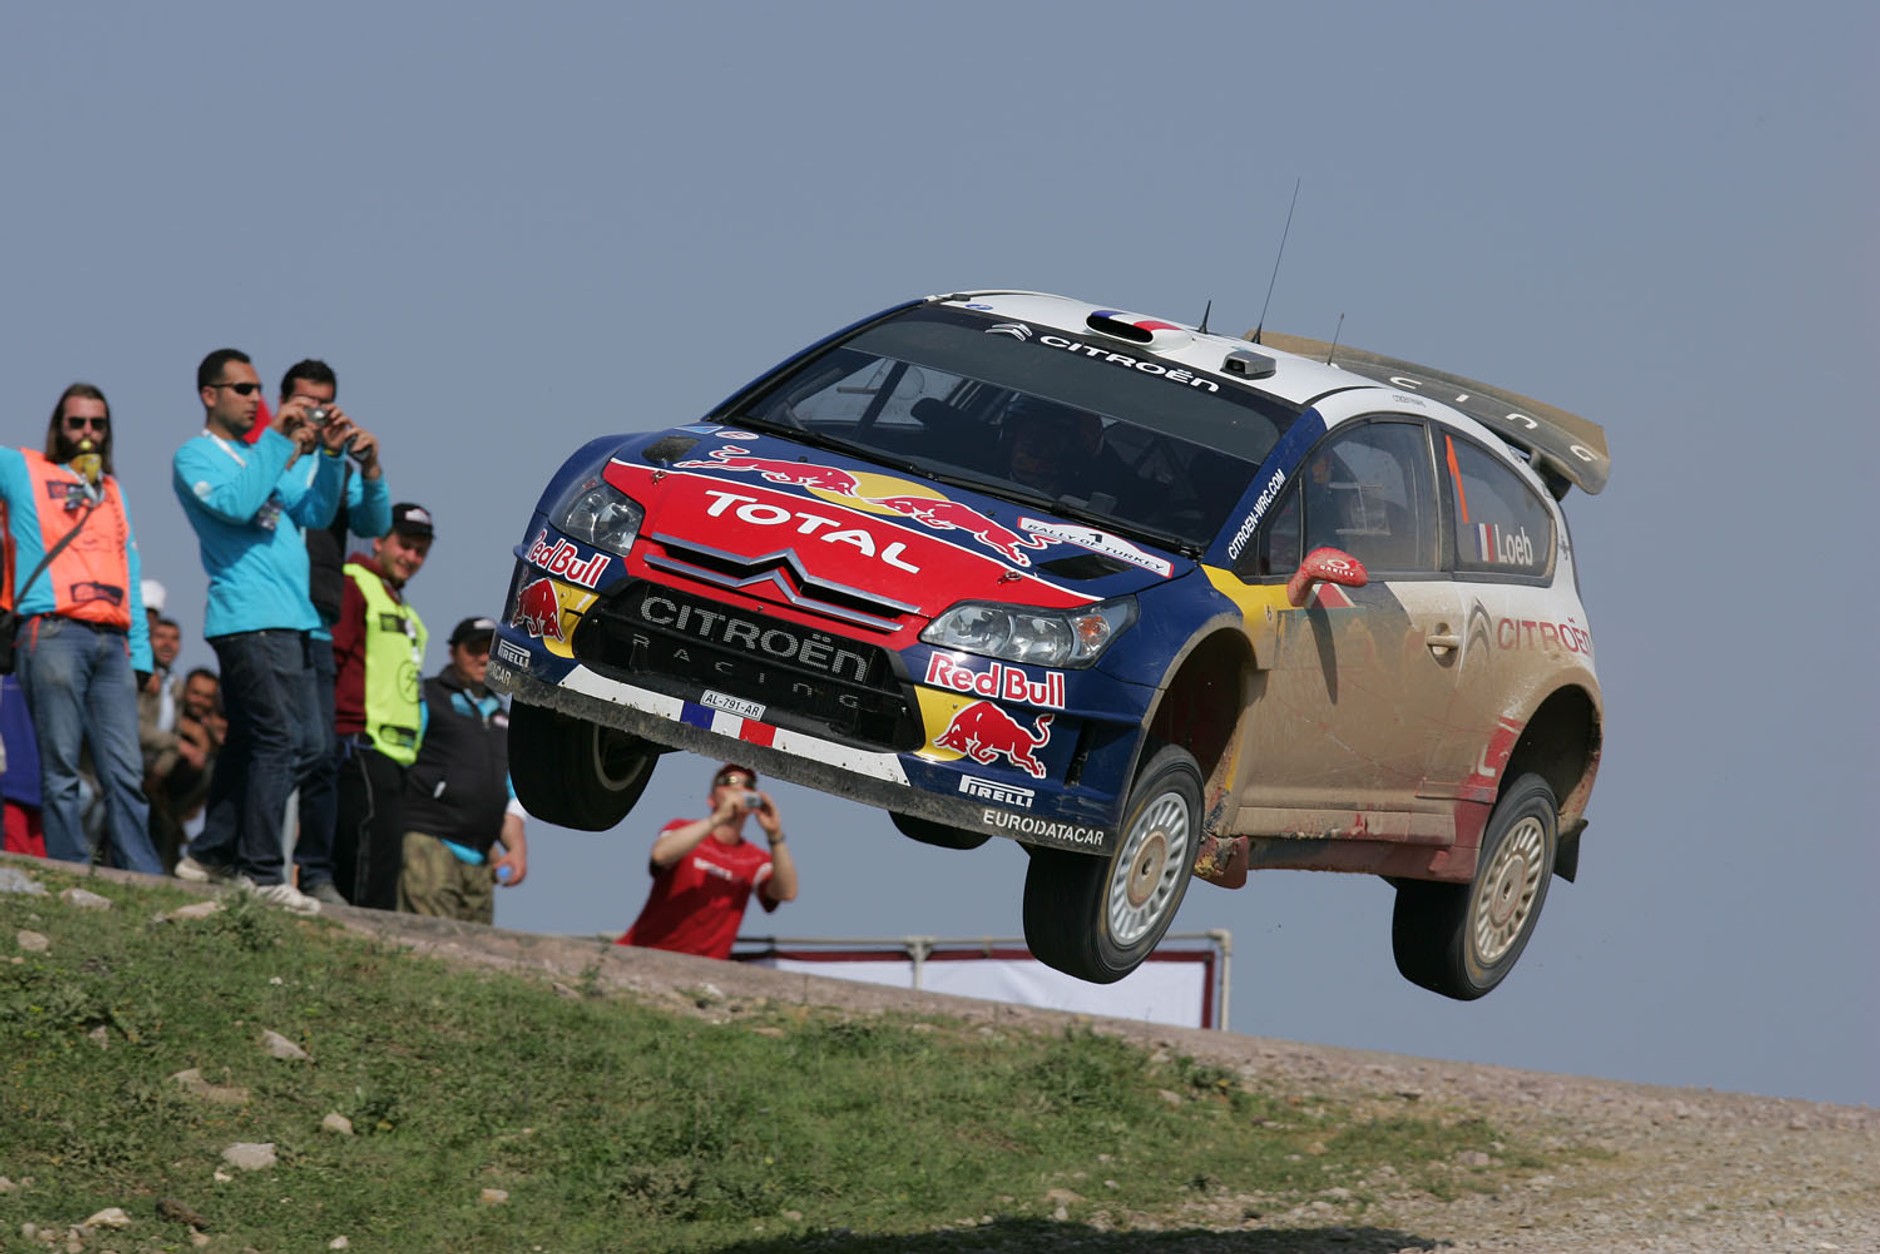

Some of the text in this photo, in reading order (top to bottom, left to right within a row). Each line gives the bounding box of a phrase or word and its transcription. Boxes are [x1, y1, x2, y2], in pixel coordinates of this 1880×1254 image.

[704, 489, 921, 574] TOTAL
[1228, 468, 1286, 560] CITROEN-WRC.COM
[525, 528, 612, 589] Red Bull
[1027, 524, 1165, 570] RALLY OF TURKEY
[1494, 523, 1533, 566] Loeb
[498, 638, 531, 669] PIRELLI
[924, 651, 1066, 710] Red Bull
[705, 693, 760, 717] AL-791-AR
[958, 774, 1036, 808] PIRELLI
[982, 809, 1105, 846] EURODATACAR
